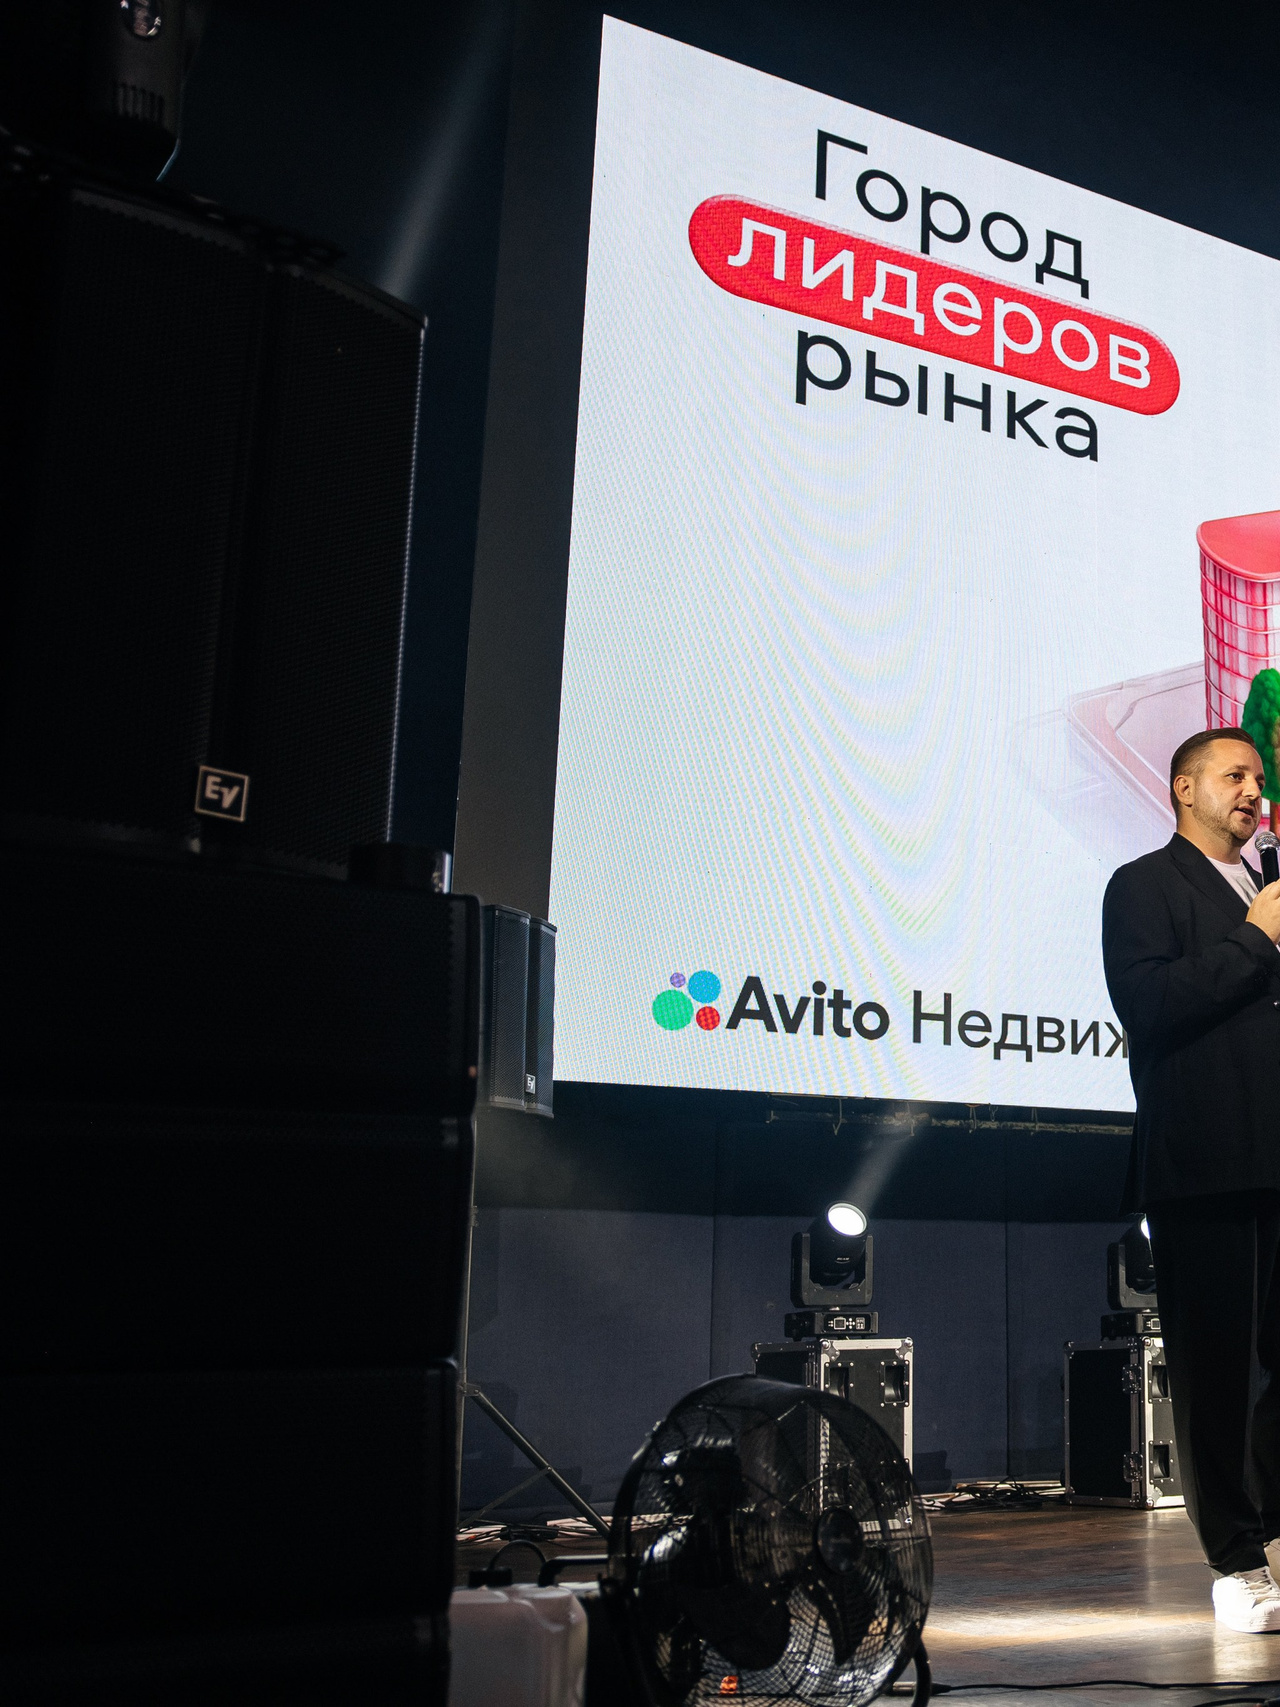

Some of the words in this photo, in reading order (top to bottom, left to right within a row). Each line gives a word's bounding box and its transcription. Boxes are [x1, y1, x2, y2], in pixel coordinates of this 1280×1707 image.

[814, 128, 1090, 300] Город
[726, 216, 1152, 390] лидеров
[795, 329, 1099, 463] рынка
[725, 975, 891, 1041] Avito
